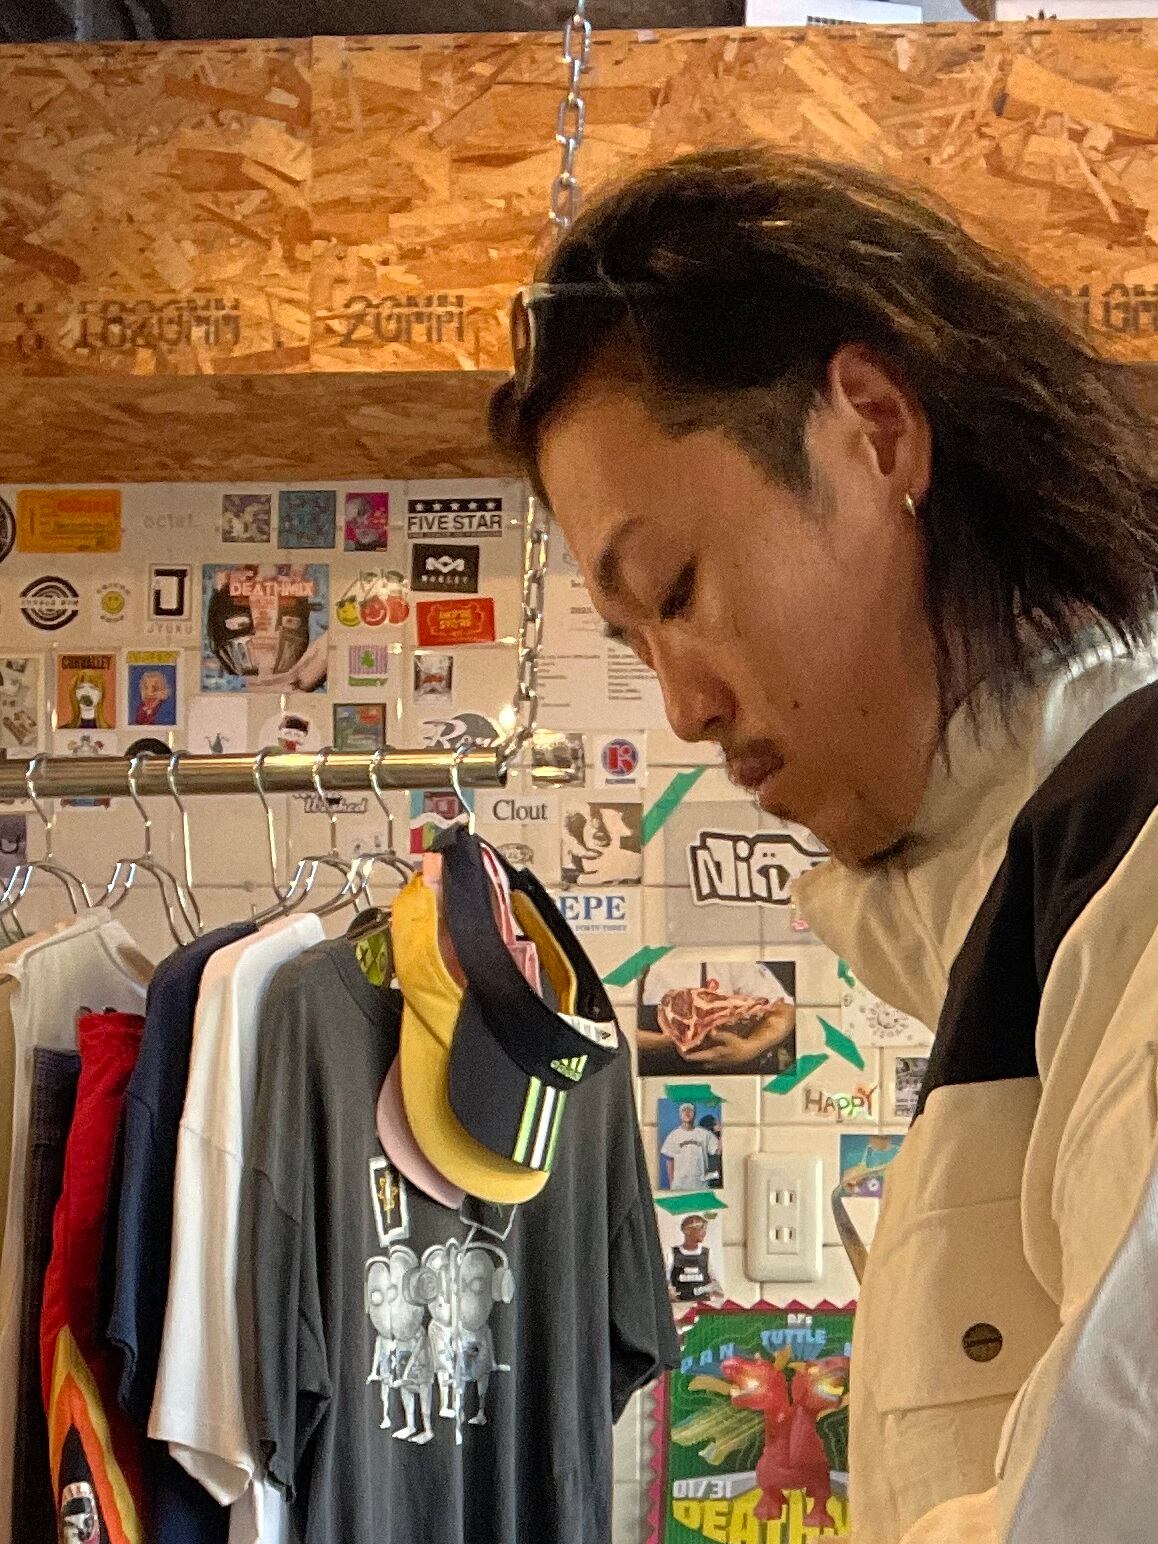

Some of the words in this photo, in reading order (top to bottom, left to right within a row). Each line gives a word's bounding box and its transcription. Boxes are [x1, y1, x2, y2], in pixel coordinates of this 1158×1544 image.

[408, 515, 448, 531] FIVE
[453, 514, 501, 530] STAR
[230, 581, 314, 596] DEATHMIX
[492, 800, 548, 821] Clout
[673, 1478, 733, 1498] 01/31
